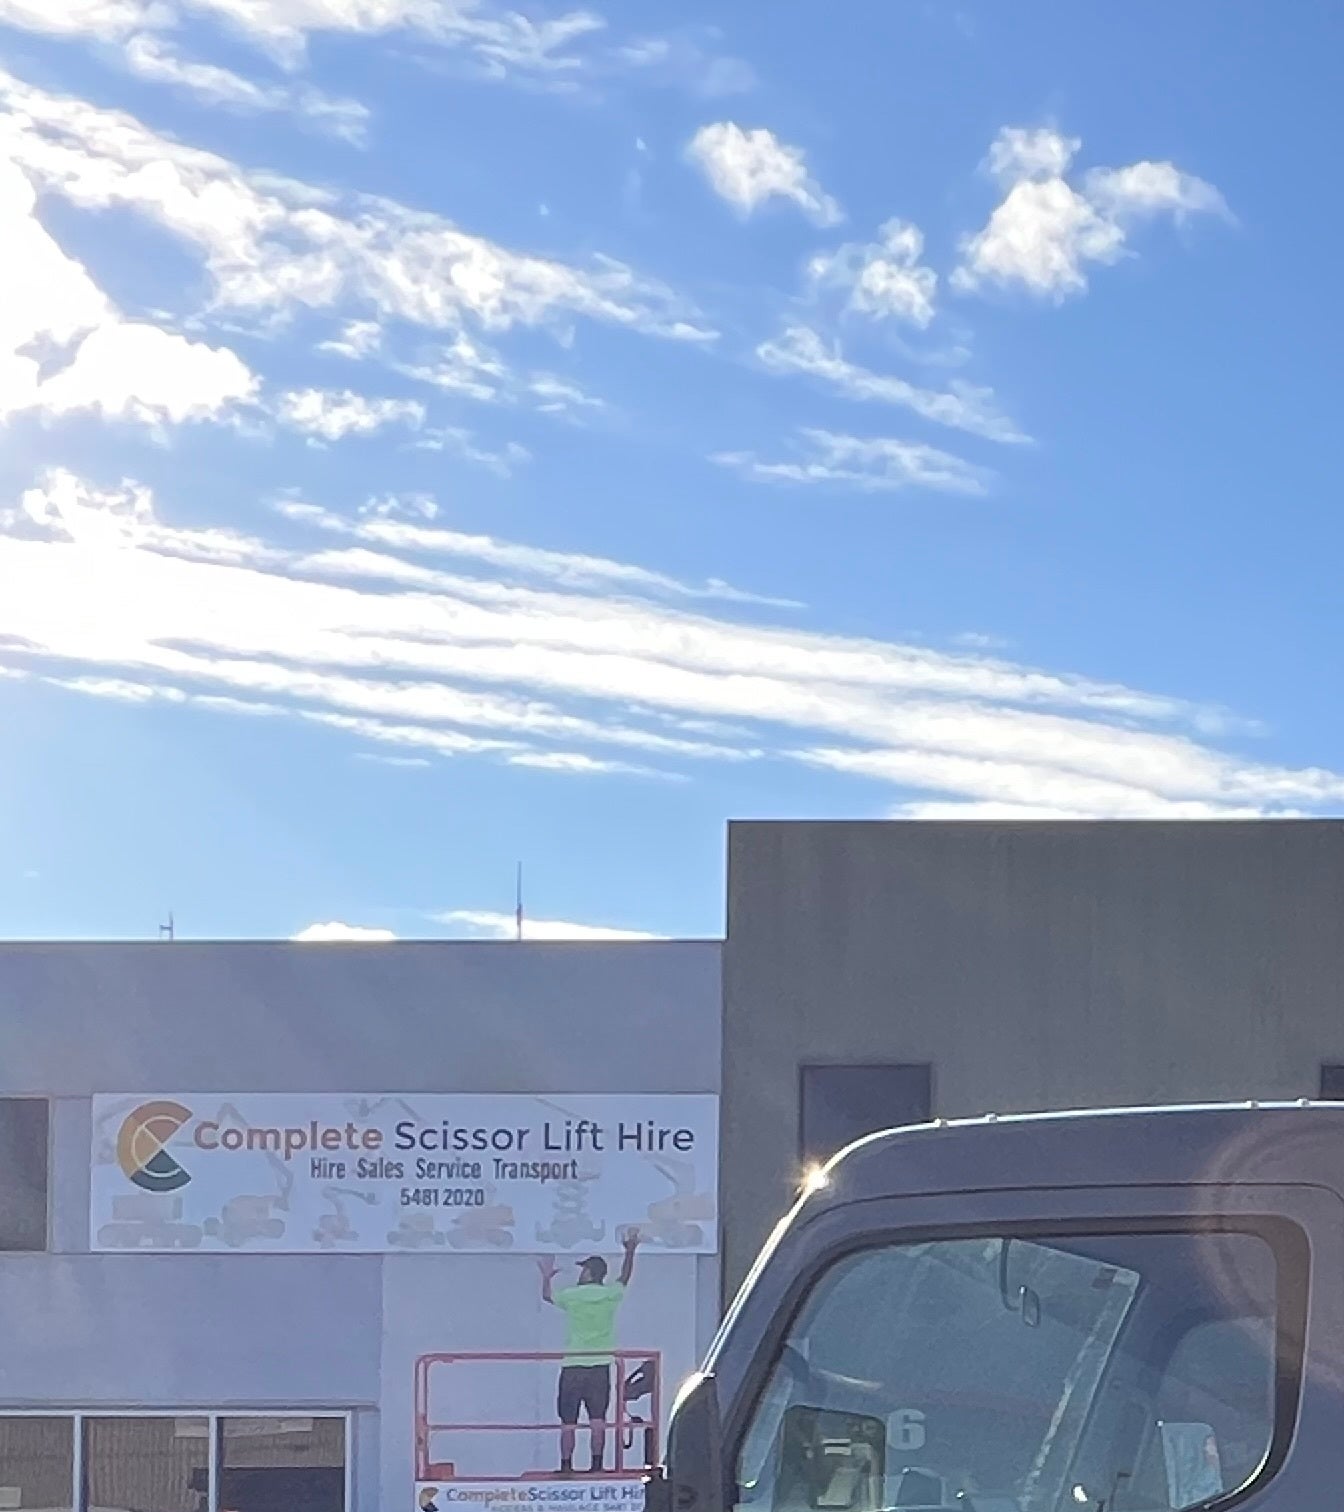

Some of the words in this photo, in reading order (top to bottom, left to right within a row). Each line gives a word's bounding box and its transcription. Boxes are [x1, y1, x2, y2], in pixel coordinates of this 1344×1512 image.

[193, 1120, 384, 1161] Complete
[394, 1120, 530, 1152] Scissor
[544, 1120, 604, 1152] Lift
[618, 1120, 695, 1152] Hire
[310, 1157, 346, 1180] Hire
[357, 1157, 404, 1180] Sales
[415, 1156, 482, 1181] Service
[492, 1157, 579, 1185] Transport
